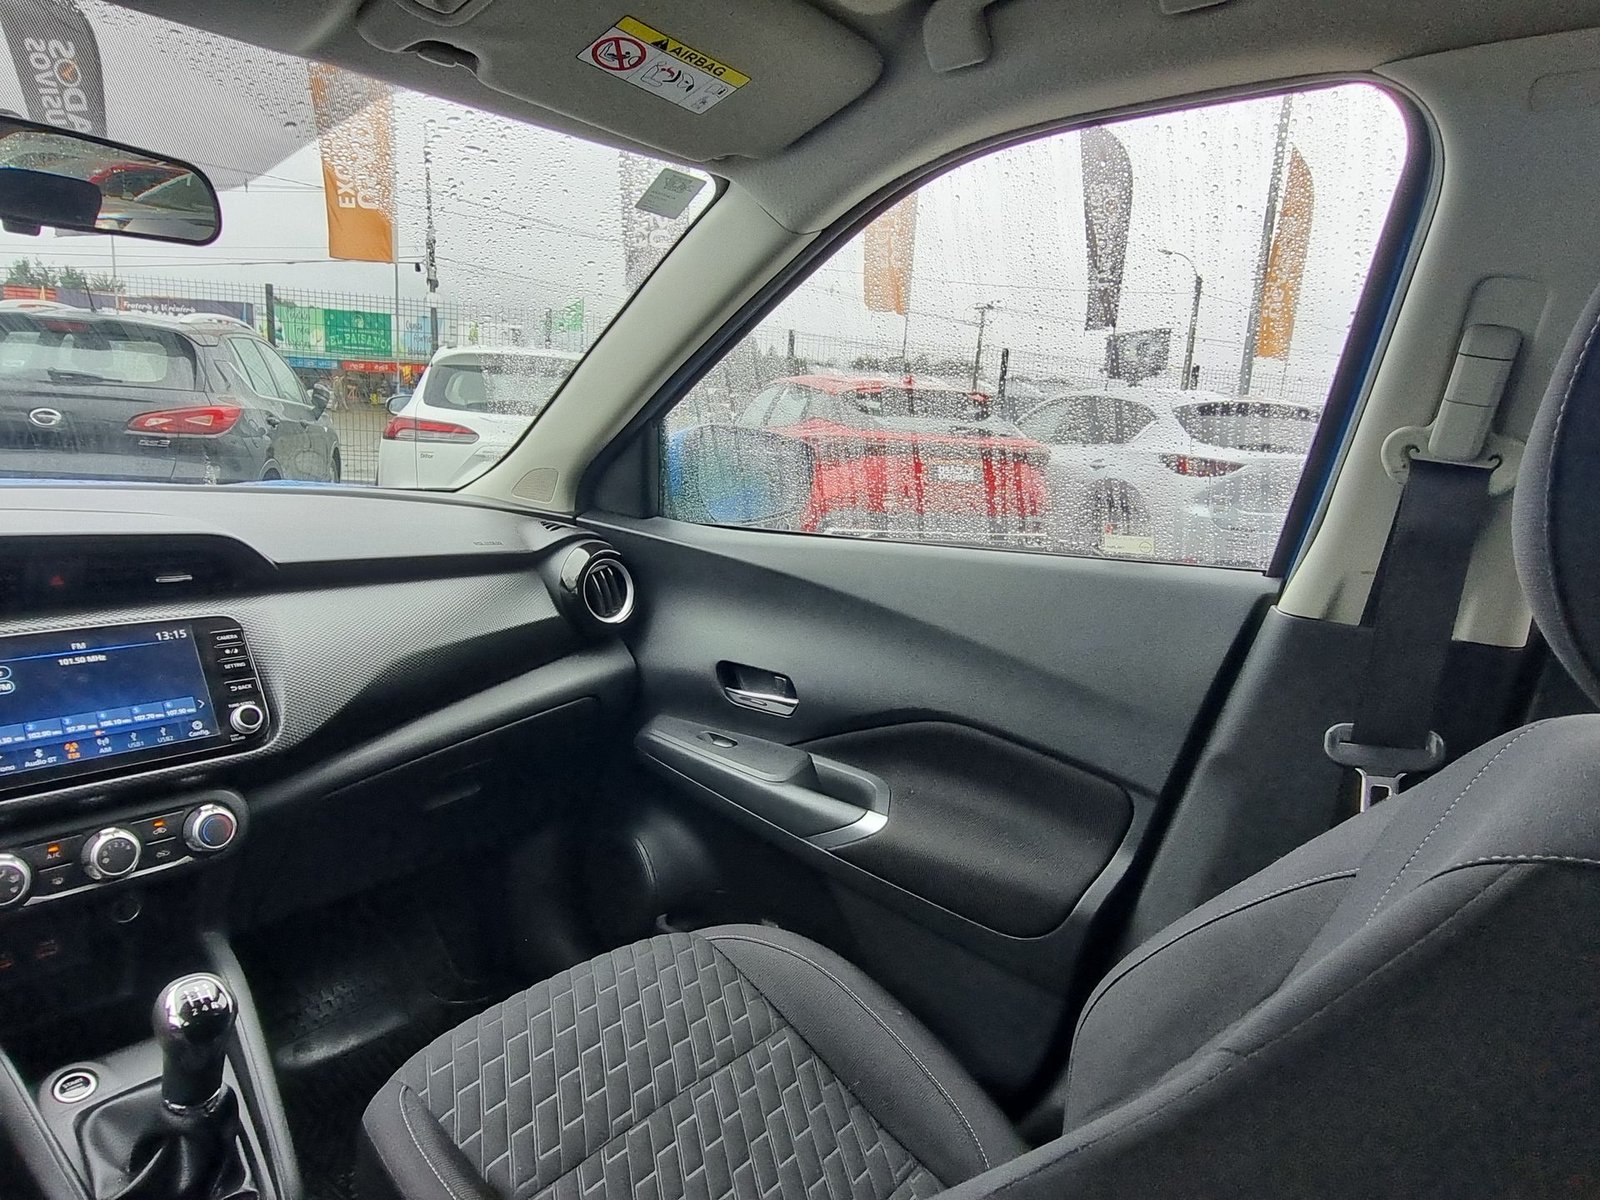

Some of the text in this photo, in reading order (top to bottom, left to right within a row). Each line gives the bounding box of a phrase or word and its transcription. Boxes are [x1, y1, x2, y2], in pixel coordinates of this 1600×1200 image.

[668, 46, 727, 77] AIRBAG
[344, 333, 387, 349] PAISANO
[155, 628, 188, 641] 13:15
[70, 642, 87, 650] FM
[58, 654, 107, 666] 101.50 MHz
[127, 741, 145, 749] USB1
[157, 736, 174, 744] USB2
[25, 758, 47, 768] Audio
[191, 1007, 199, 1016] 2
